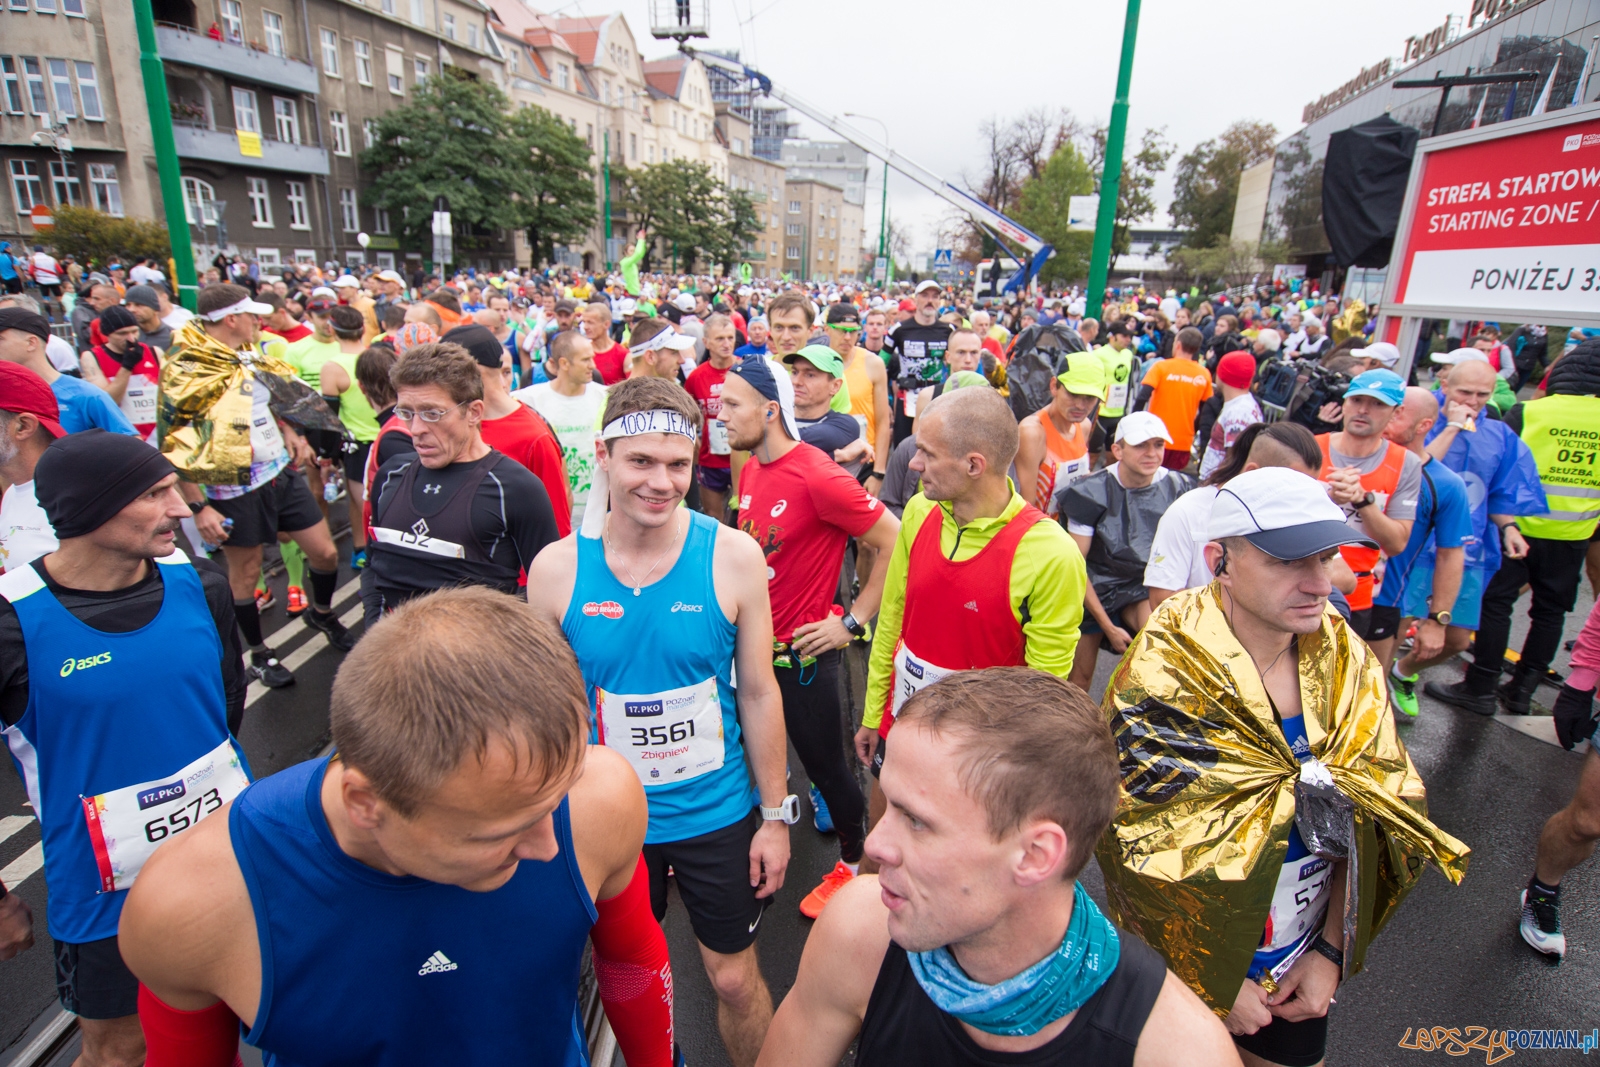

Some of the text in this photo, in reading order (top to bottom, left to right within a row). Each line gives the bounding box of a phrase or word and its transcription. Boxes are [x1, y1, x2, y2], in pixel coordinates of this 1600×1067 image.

[1427, 166, 1600, 207] STREFA STARTOW
[1428, 206, 1515, 234] STARTING
[1519, 201, 1583, 227] ZONE
[1471, 260, 1575, 292] PONIŻEJ
[133, 399, 155, 408] 1103
[621, 411, 657, 435] 100%
[1549, 428, 1600, 440] OCHRO
[1557, 449, 1597, 465] 051
[1539, 474, 1600, 487] NFORMACYJNA
[681, 604, 703, 612] asics
[76, 651, 112, 670] asics
[631, 719, 695, 746] 3561
[641, 745, 689, 760] Zbigniew
[145, 787, 223, 843] 6573
[418, 962, 458, 976] adidas
